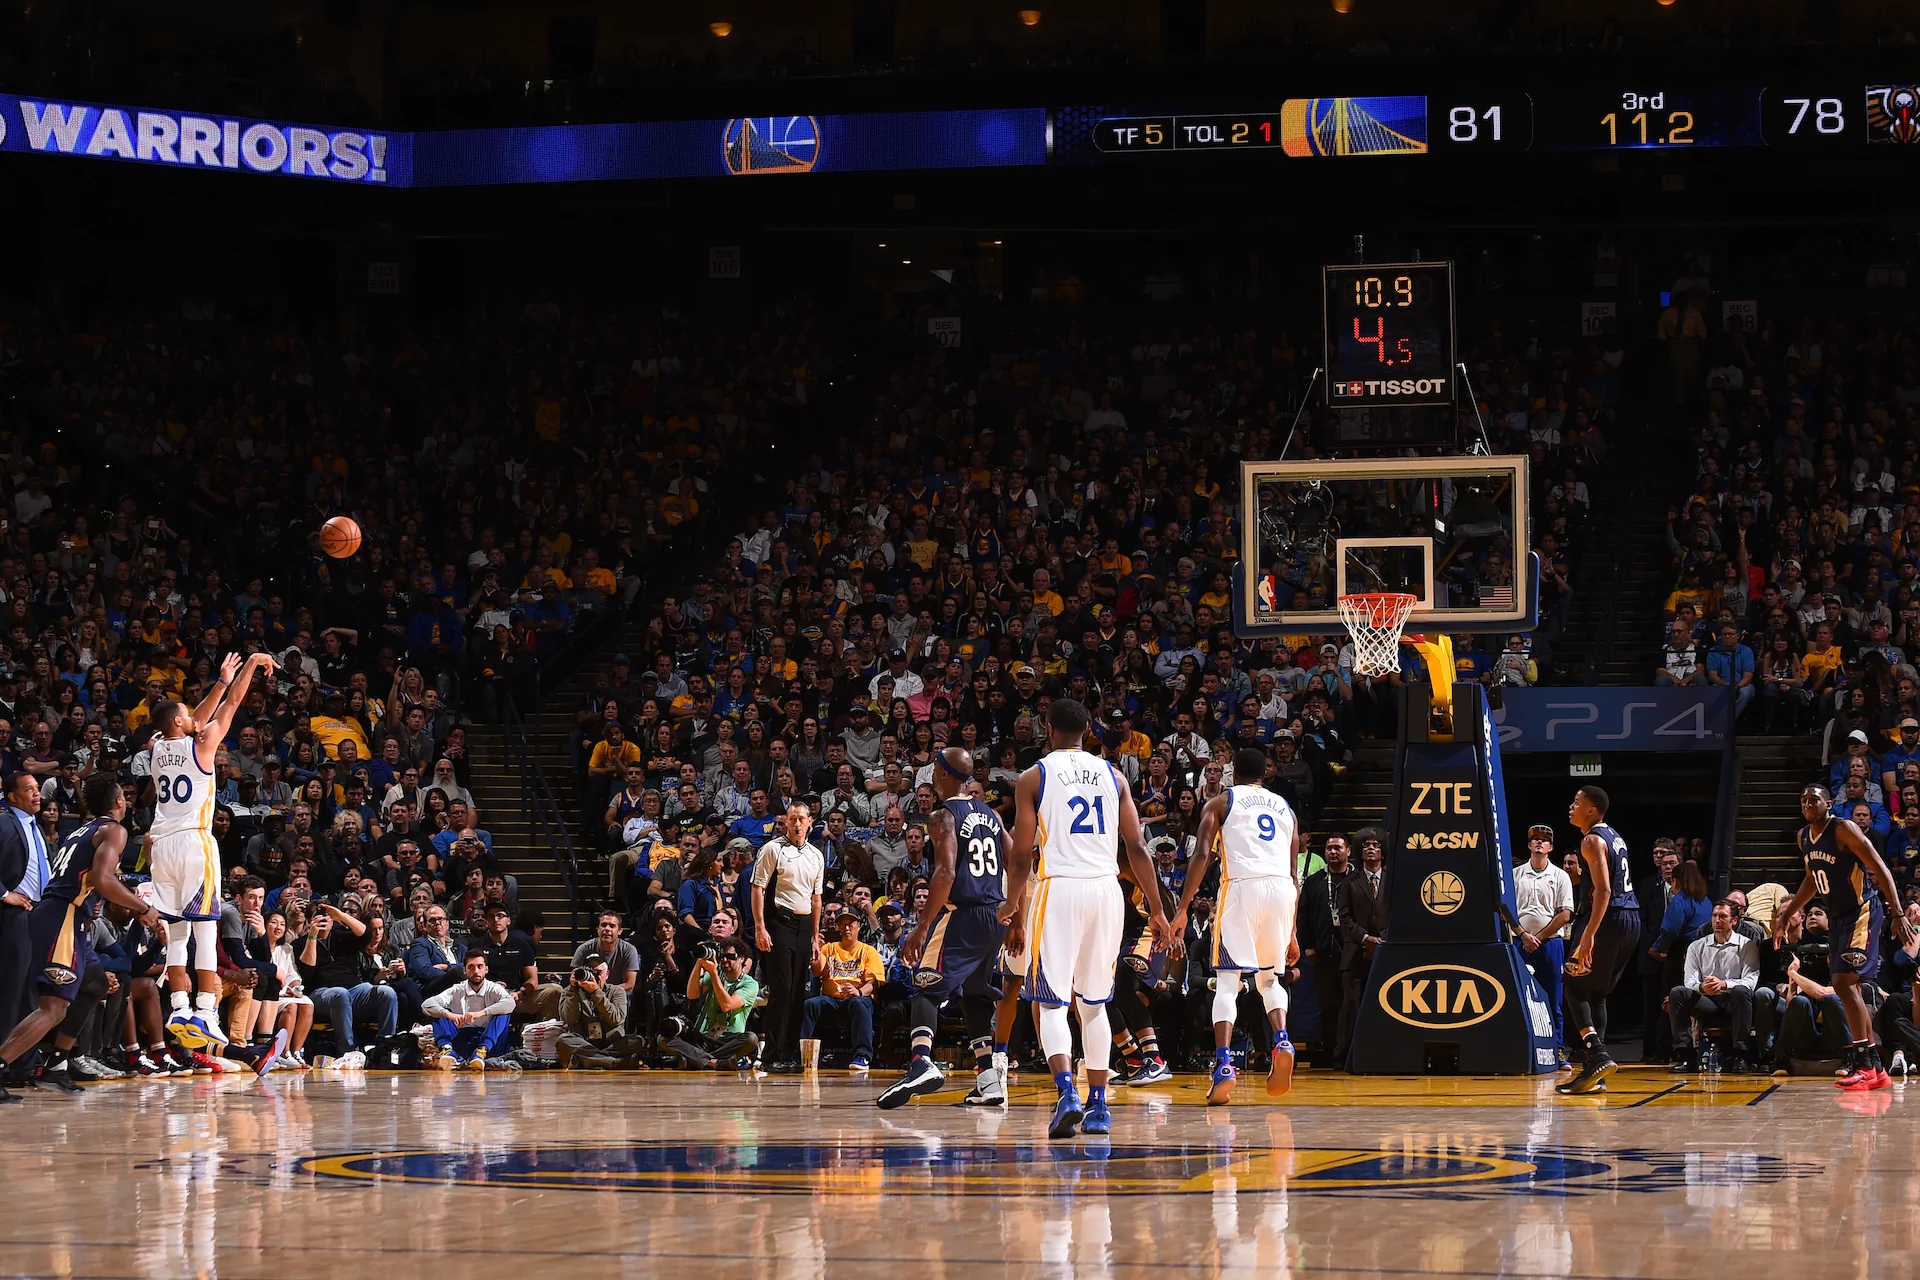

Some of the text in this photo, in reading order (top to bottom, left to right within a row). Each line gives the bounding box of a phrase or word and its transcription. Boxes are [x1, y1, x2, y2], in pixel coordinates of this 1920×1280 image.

[1622, 92, 1664, 111] 3rd
[1449, 106, 1501, 142] 81
[1601, 110, 1694, 146] 11.2
[1784, 98, 1845, 134] 78
[19, 101, 387, 182] WARRIORS!
[1113, 124, 1163, 145] TF 5
[1183, 122, 1271, 144] TOL 2 1
[370, 279, 396, 288] EXIT
[1355, 276, 1413, 307] 10.9
[1588, 306, 1609, 315] SEC
[935, 321, 954, 330] SEC
[1365, 379, 1446, 396] TISSOT
[1546, 702, 1712, 739] PS4
[157, 754, 187, 769] CURRY
[1576, 755, 1597, 772] EXIT
[158, 774, 193, 804] 30
[1057, 769, 1102, 787] CLARK
[1237, 795, 1286, 816] IGUODALA
[1410, 782, 1473, 815] ZTE
[1066, 795, 1106, 835] 21
[1257, 813, 1276, 842] 9
[1433, 831, 1480, 850] CSN
[967, 836, 999, 878] 33
[1809, 850, 1837, 865] ORLEANS
[1621, 856, 1634, 893] 2
[1811, 868, 1831, 895] 10
[1400, 979, 1485, 1014] KIA
